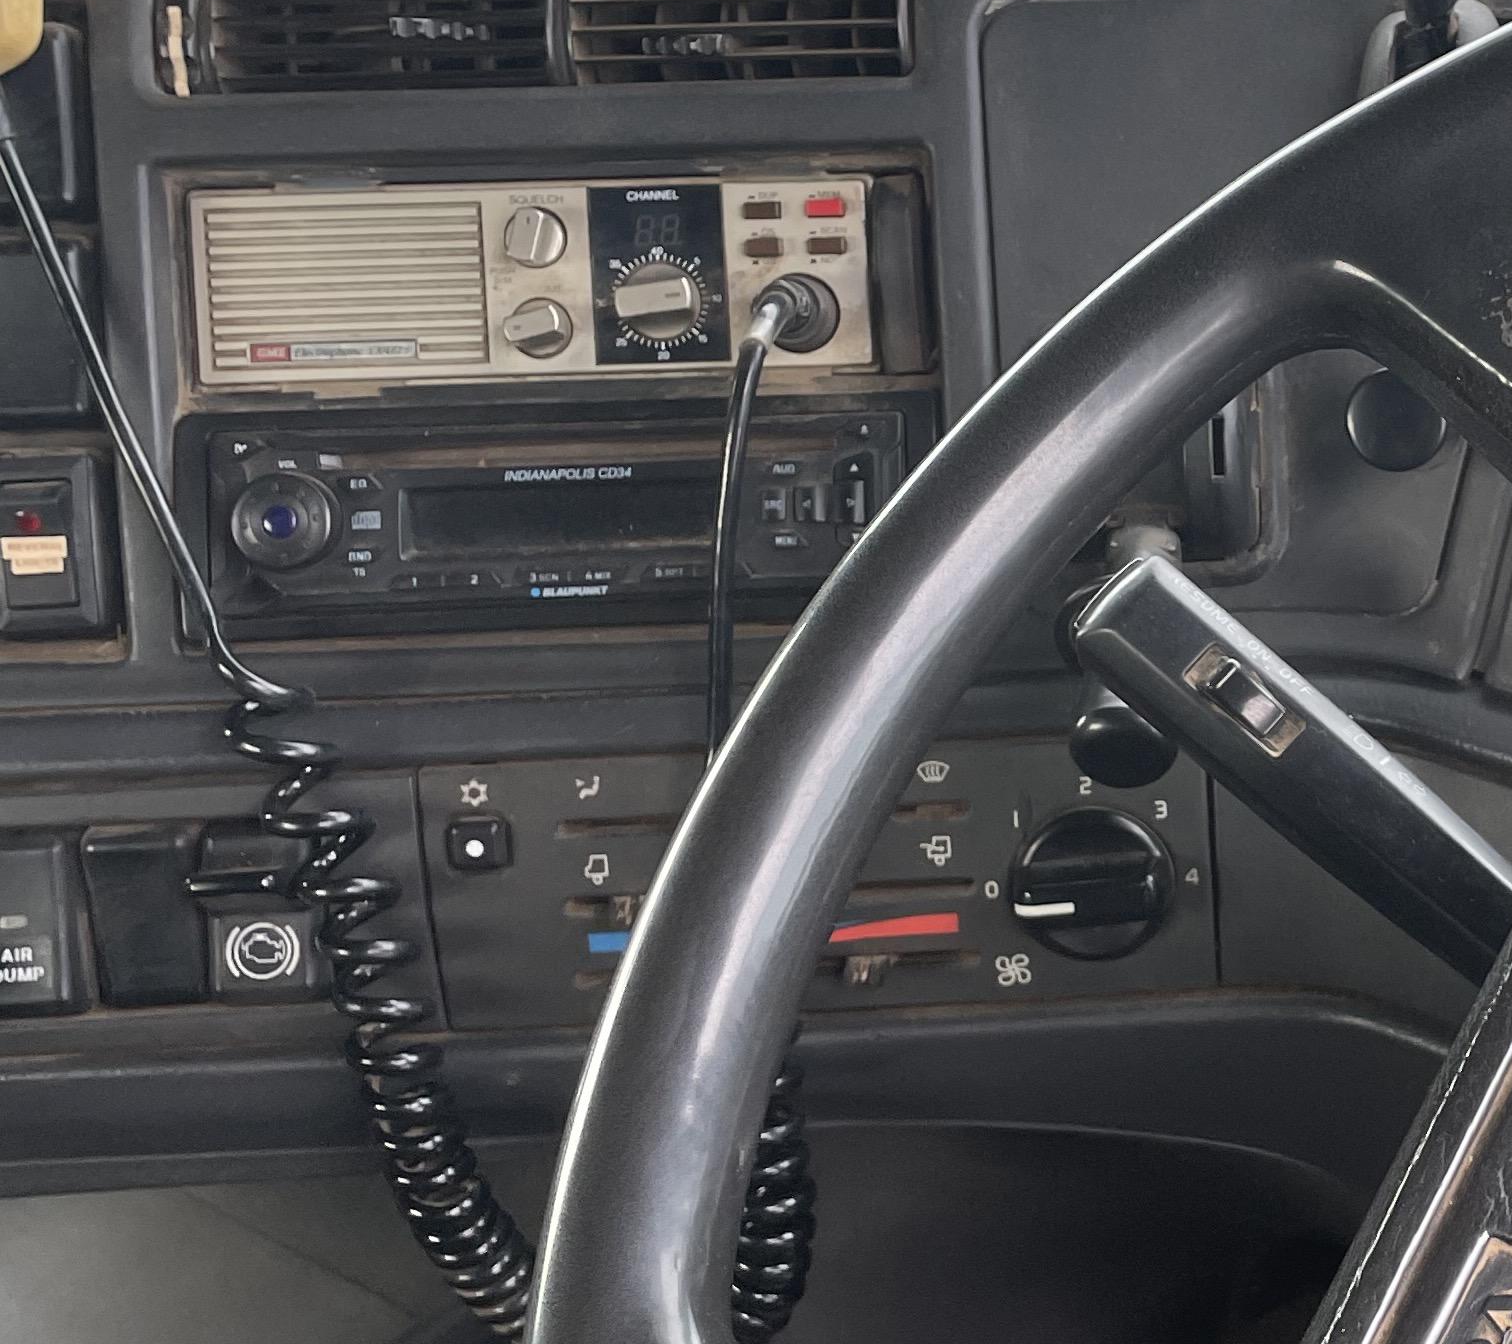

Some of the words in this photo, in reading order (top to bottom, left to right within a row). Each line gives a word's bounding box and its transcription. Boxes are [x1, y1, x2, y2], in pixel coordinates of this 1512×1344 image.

[509, 194, 565, 205] SQUELCH
[626, 189, 680, 202] CHANNEL
[504, 466, 595, 482] INDIANAPOLIS
[598, 465, 633, 480] CD34
[470, 574, 480, 586] 2
[542, 584, 609, 599] BLAUPUNKT
[1078, 775, 1093, 795] 2
[1153, 799, 1169, 820] 3
[1184, 867, 1200, 886] 4
[983, 879, 1000, 899] 0
[1, 946, 33, 964] AIR
[0, 965, 45, 984] UMP
